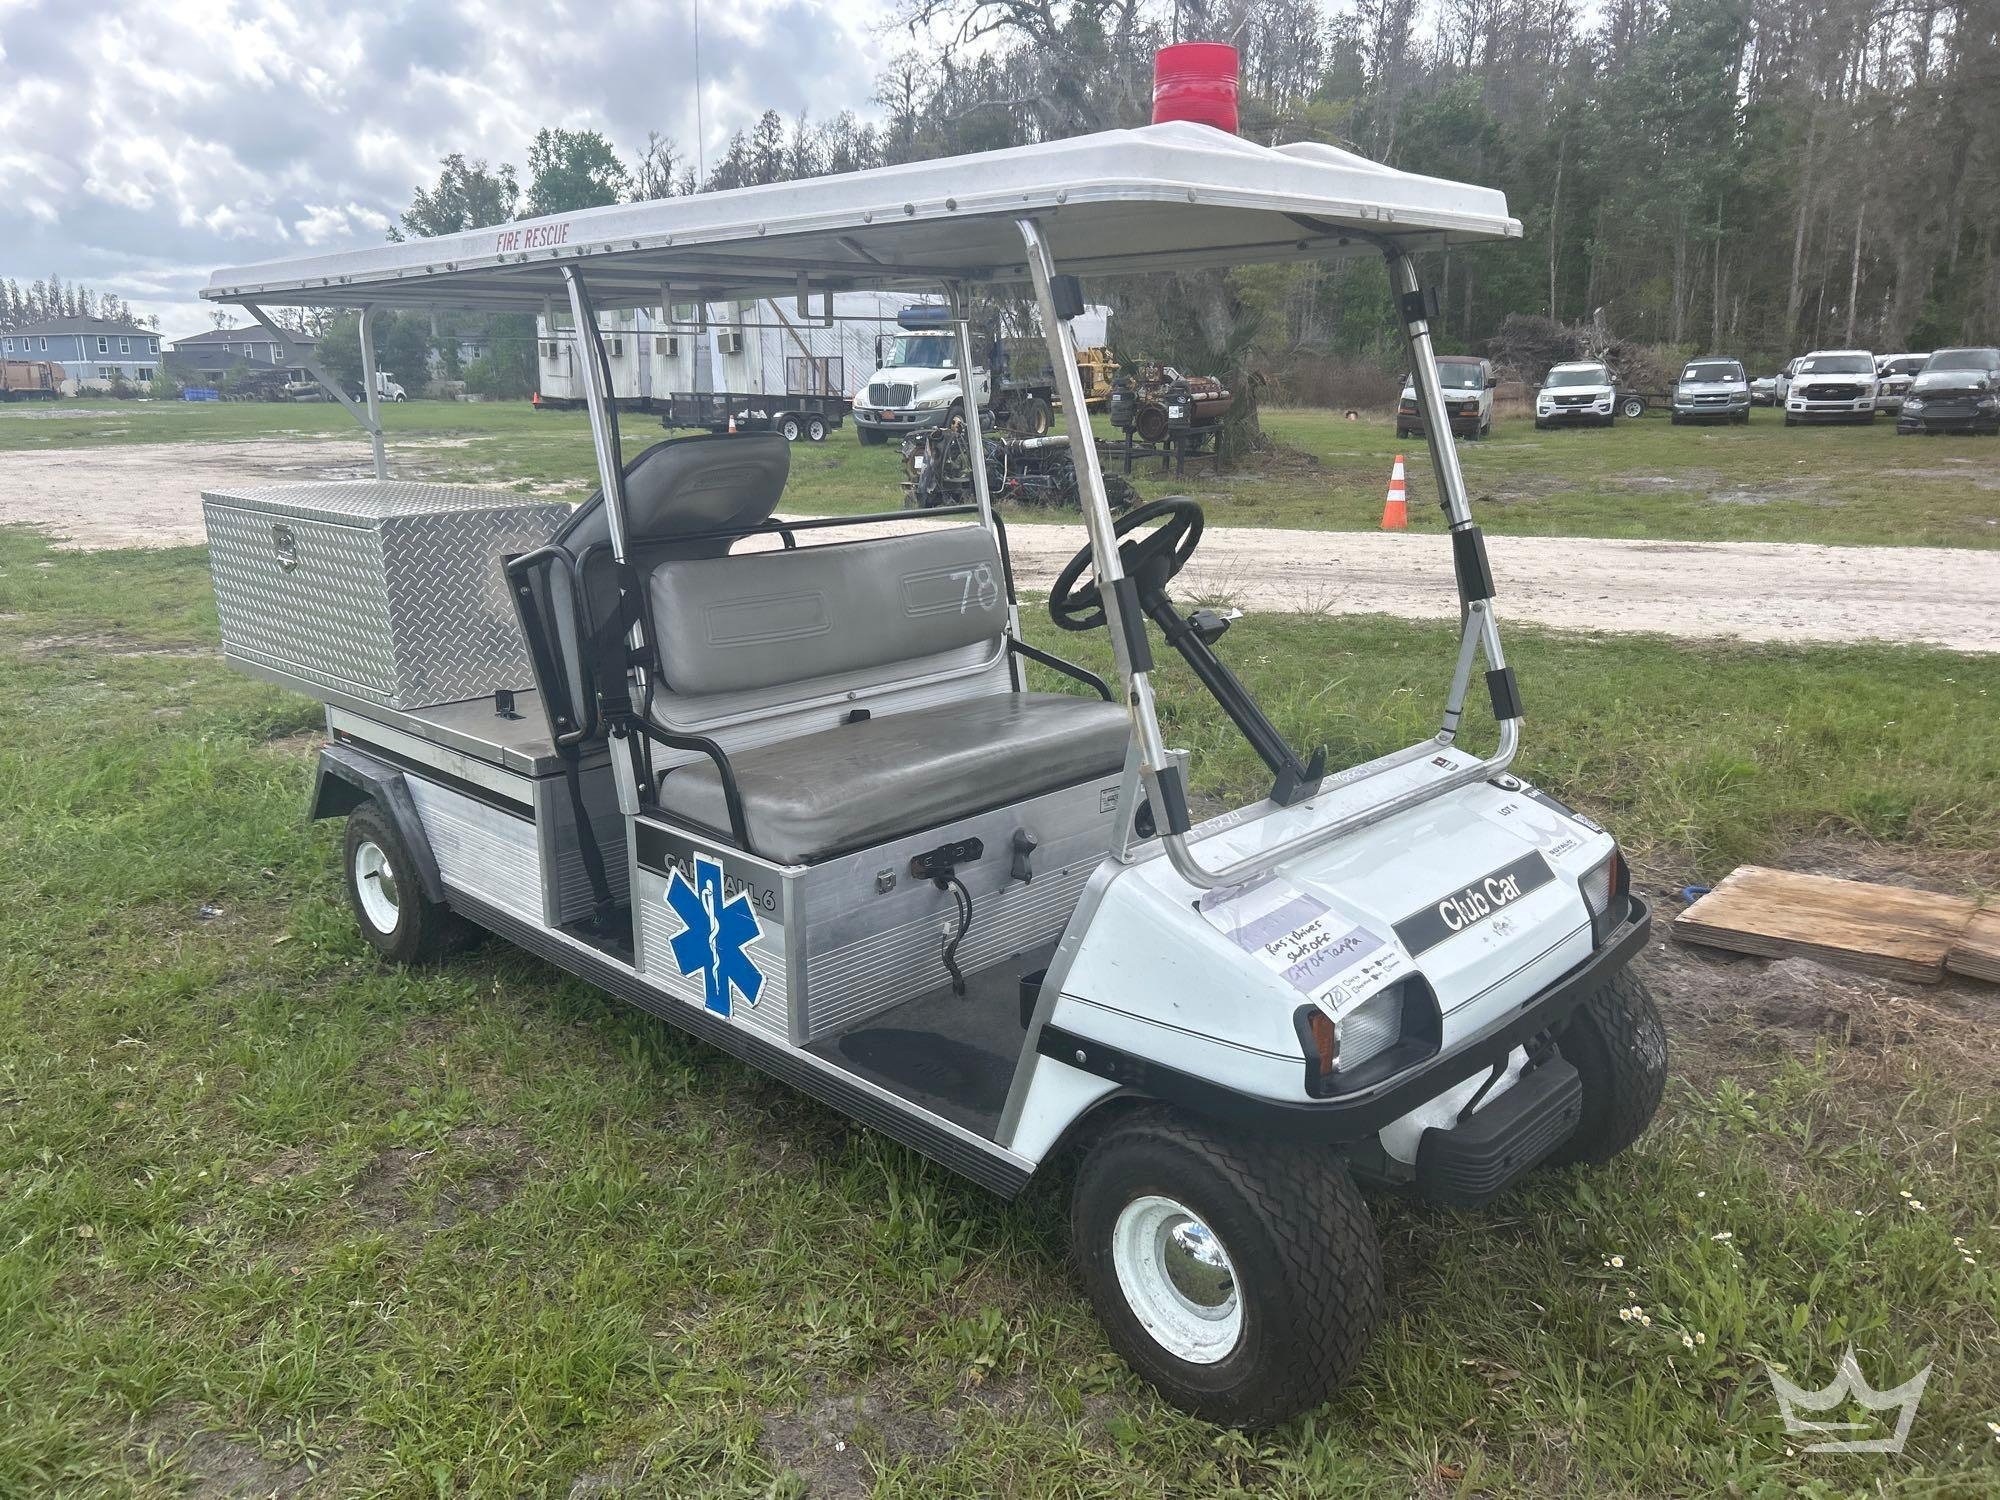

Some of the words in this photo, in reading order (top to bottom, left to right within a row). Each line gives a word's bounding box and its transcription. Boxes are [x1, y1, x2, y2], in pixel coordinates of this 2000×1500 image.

[496, 231, 521, 252] FIRE
[524, 223, 570, 249] RESCUE
[949, 562, 998, 616] 78
[1496, 806, 1513, 816] LOT
[1439, 888, 1490, 931] Club
[1484, 873, 1522, 906] Car
